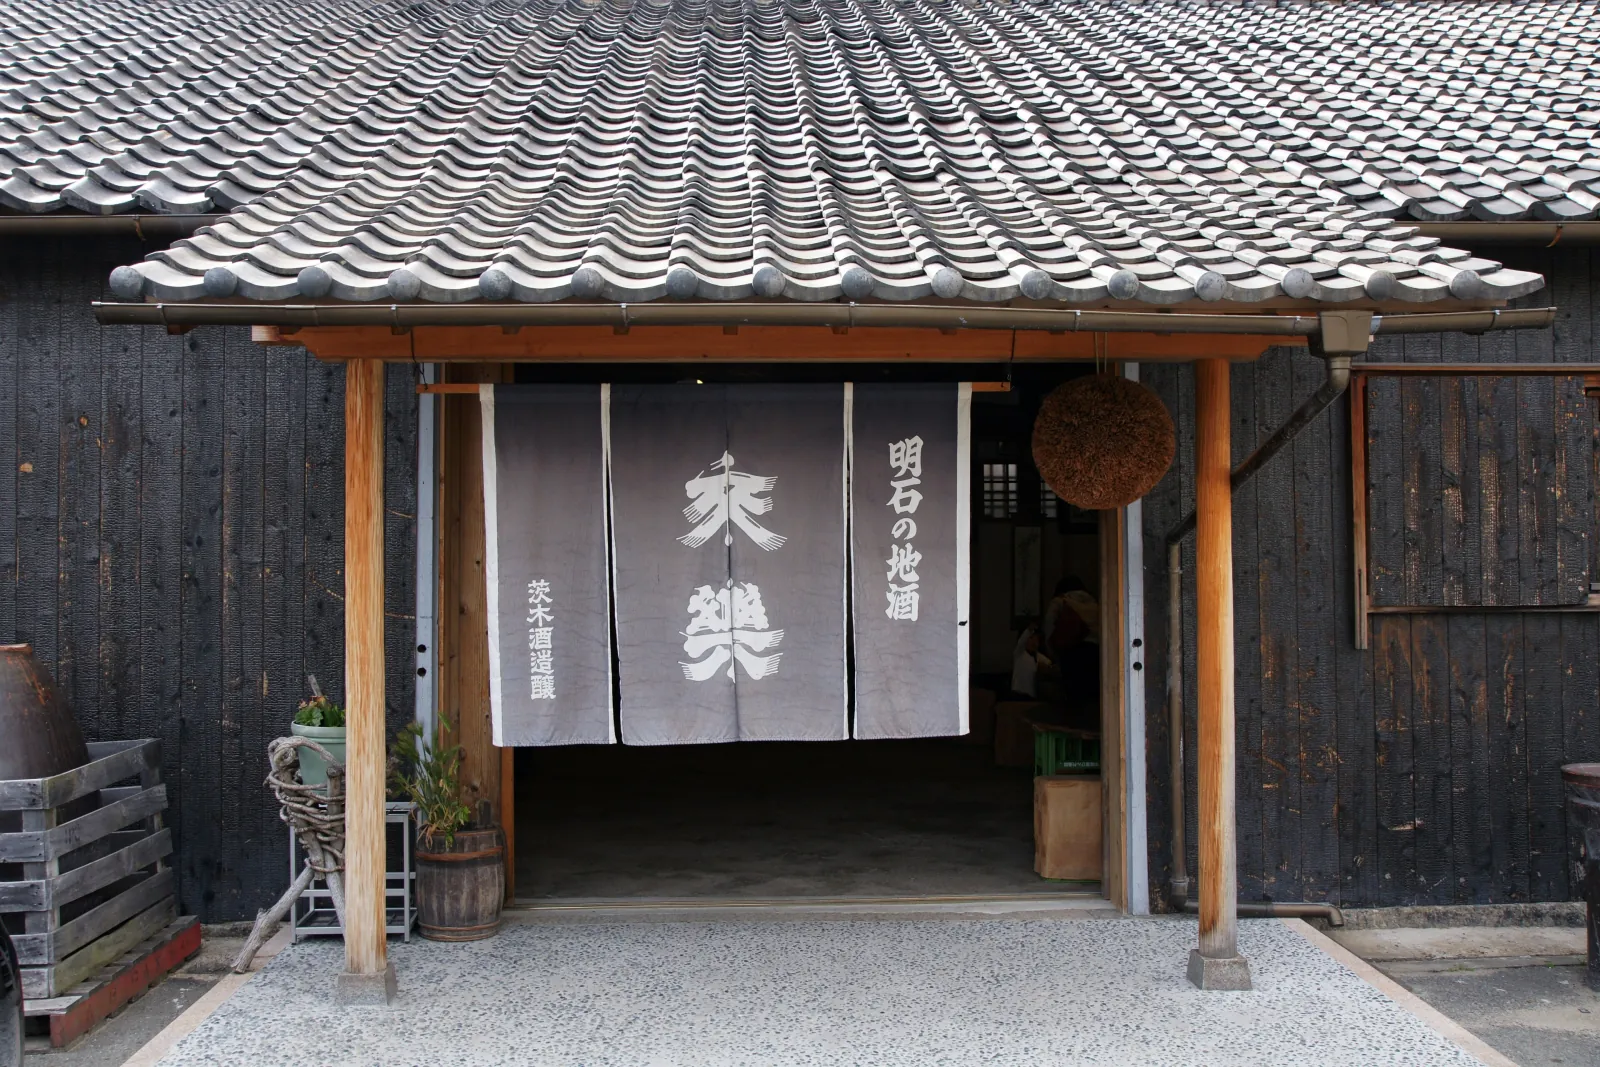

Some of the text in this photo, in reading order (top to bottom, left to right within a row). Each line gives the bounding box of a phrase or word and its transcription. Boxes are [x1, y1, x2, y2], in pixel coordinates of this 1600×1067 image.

[885, 435, 924, 621] 明石の地酒
[526, 578, 556, 700] 茨木酒造醸
